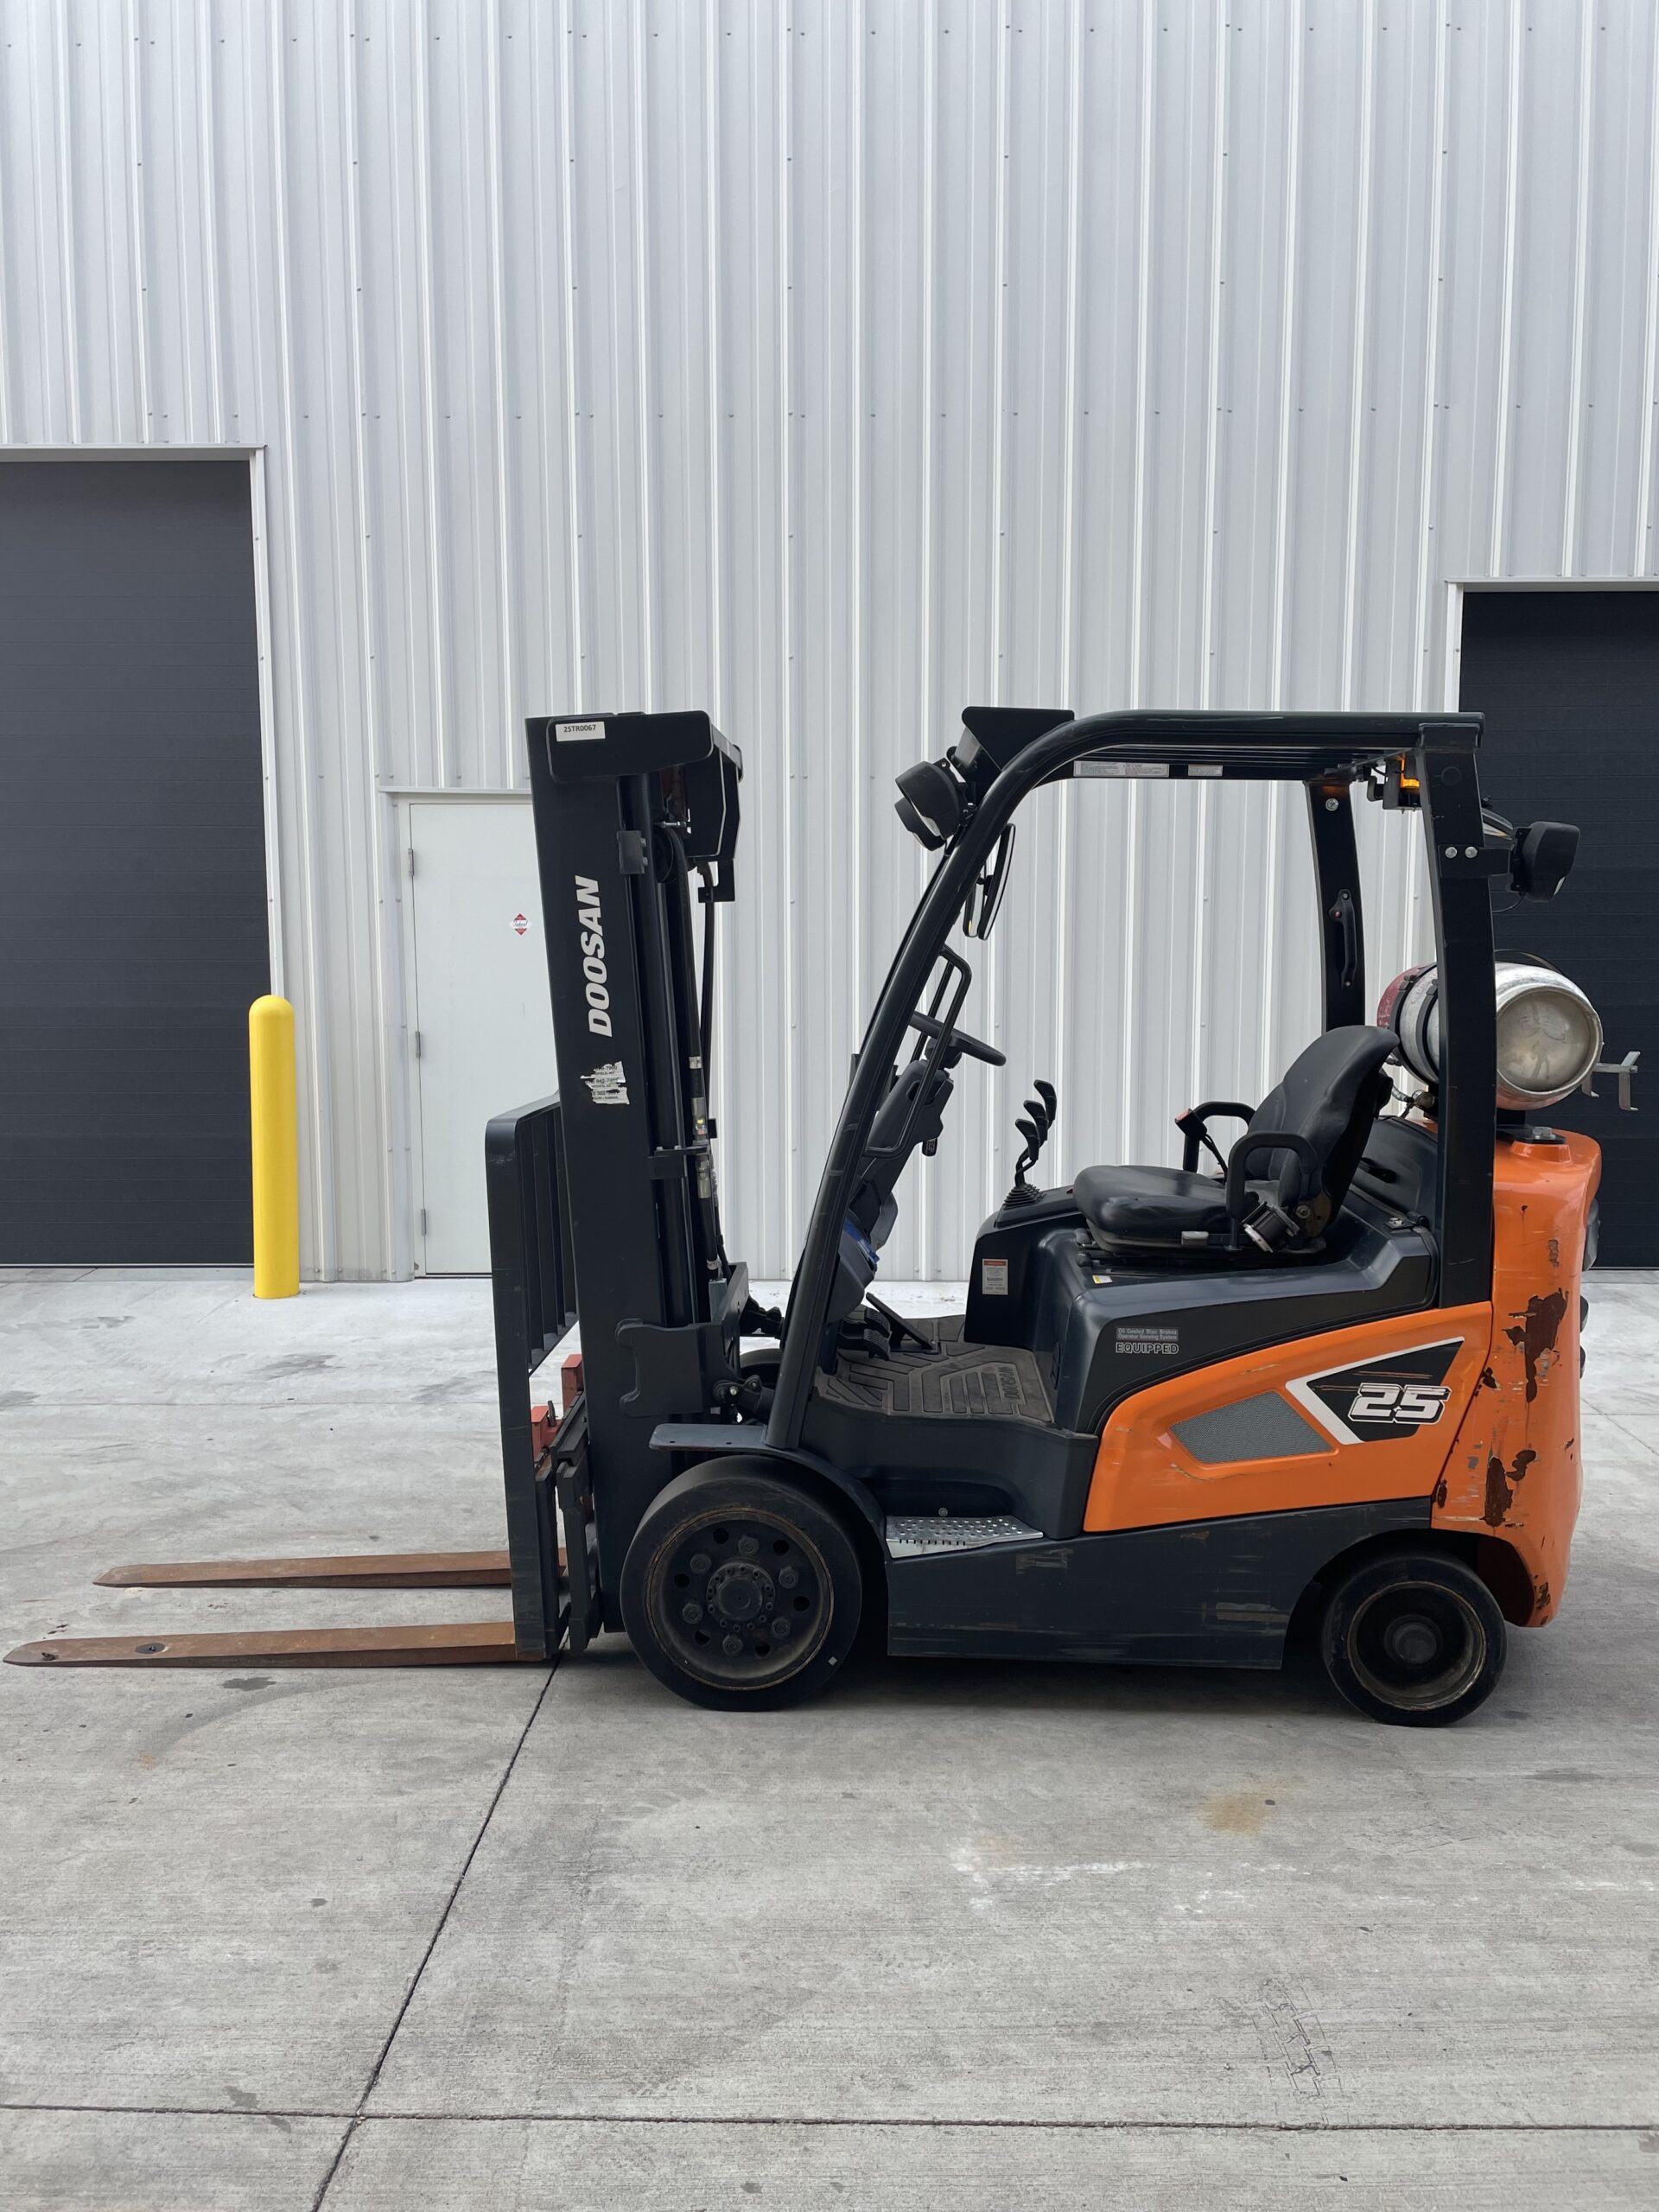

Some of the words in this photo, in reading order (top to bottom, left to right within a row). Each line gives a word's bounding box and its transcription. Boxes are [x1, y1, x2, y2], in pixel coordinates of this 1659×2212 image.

[575, 874, 613, 1037] DOOSAN
[1116, 1342, 1179, 1355] EQUIPPED
[1347, 1382, 1452, 1425] 25
